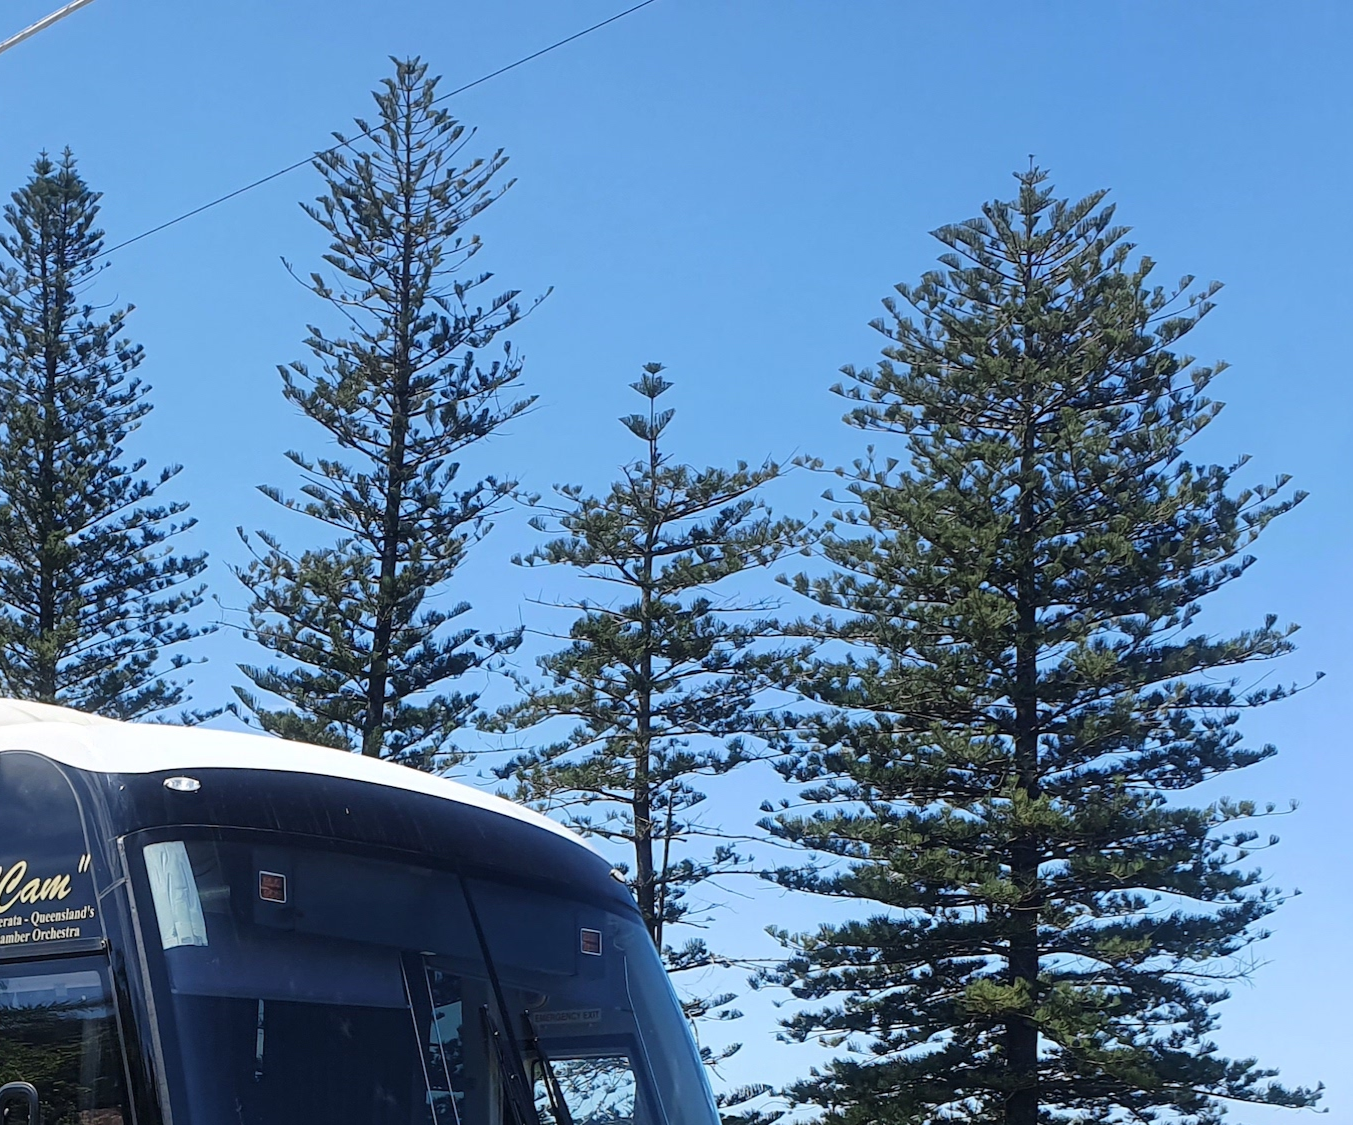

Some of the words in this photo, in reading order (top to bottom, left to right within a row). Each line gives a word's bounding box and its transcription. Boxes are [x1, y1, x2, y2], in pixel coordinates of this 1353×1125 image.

[30, 905, 95, 927] Queensland's
[32, 926, 80, 941] Orchestra
[534, 1012, 581, 1023] EMERGENCY
[583, 1010, 600, 1020] EXIT
